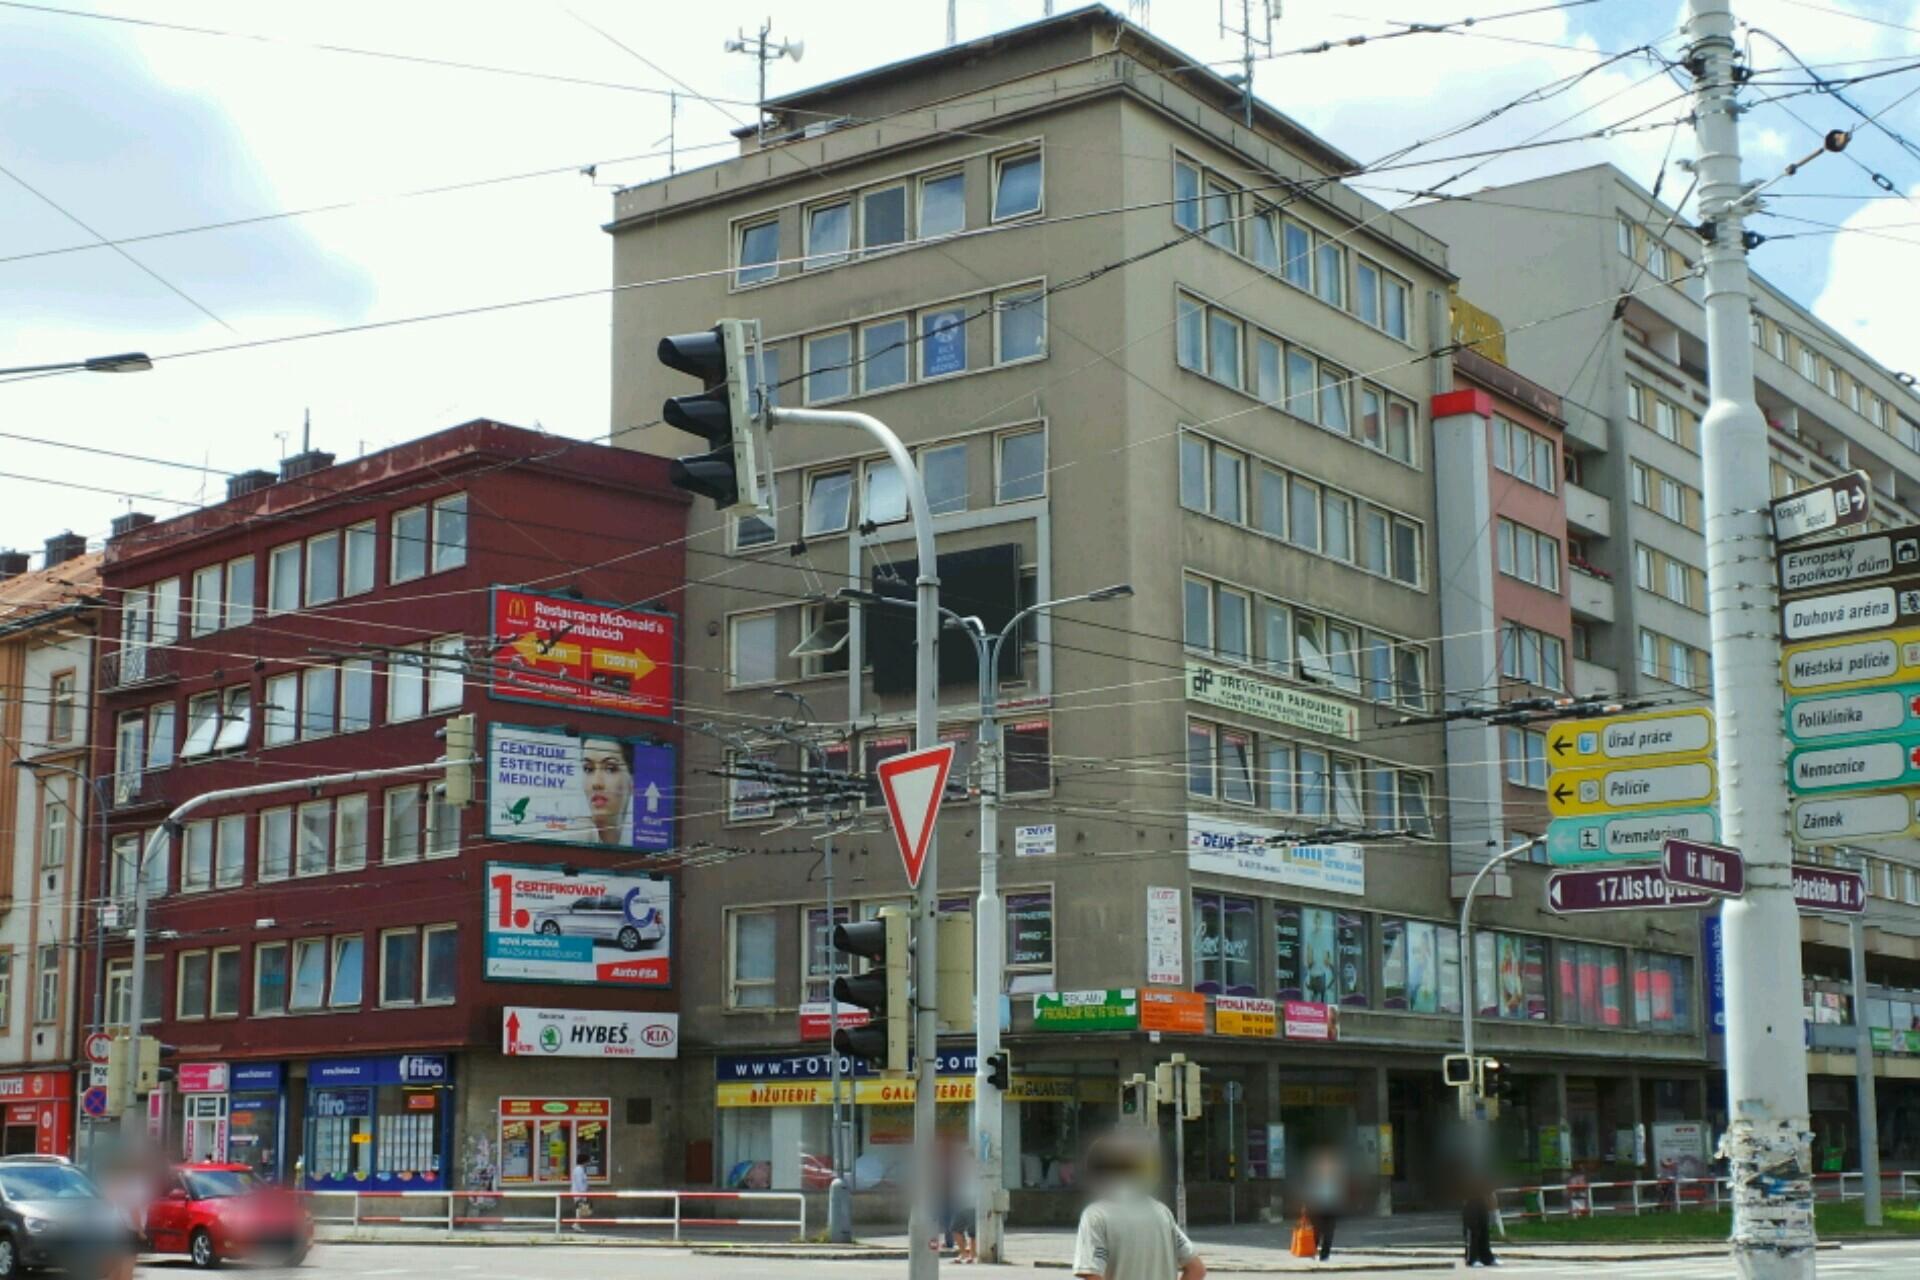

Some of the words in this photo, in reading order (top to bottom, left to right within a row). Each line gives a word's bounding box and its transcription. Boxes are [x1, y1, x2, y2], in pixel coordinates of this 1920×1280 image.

[1788, 545, 1856, 569] Evropský
[1788, 563, 1853, 586] spolkový
[1857, 557, 1890, 574] dům
[534, 601, 598, 622] Restaurace
[1792, 605, 1846, 628] Duhová
[1850, 602, 1890, 619] aréna
[1794, 657, 1844, 679] Městská
[1848, 652, 1890, 675] policie
[1287, 692, 1344, 719] PARDUBICE
[1798, 708, 1863, 729] Poliklinika
[1607, 730, 1635, 749] Úřad
[1638, 729, 1673, 749] práce
[500, 741, 566, 758] CENTRUM
[500, 757, 575, 776] ESTETICKÉ
[1799, 758, 1865, 779] Nemocnice
[499, 771, 566, 790] MEDICÍNY
[1610, 778, 1651, 797] Policie
[1802, 811, 1844, 830] Zámek
[1610, 825, 1689, 845] Krematorium
[514, 879, 608, 897] CERTIFIKOVANÝ
[1792, 875, 1839, 903] alackého
[610, 967, 637, 977] Auto
[570, 1022, 629, 1045] HYBEŠ
[646, 1029, 670, 1042] KIA
[409, 1058, 444, 1077] firo
[881, 1083, 974, 1101] GALTERIE
[318, 1092, 345, 1116] firo
